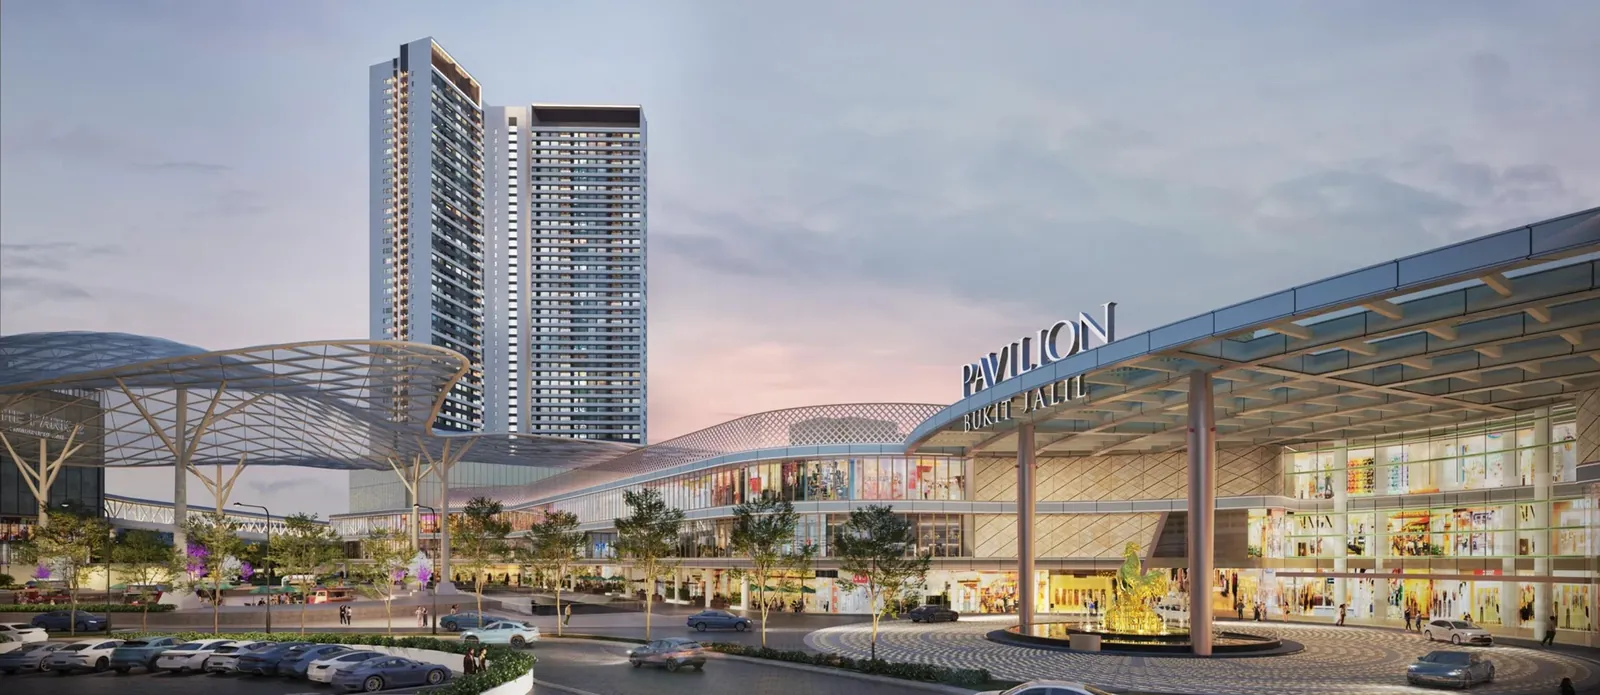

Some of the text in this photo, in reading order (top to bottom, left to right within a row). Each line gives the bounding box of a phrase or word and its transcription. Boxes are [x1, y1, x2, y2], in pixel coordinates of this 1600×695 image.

[961, 301, 1118, 400] PAVILION
[964, 373, 1087, 433] BUKIT JALIL
